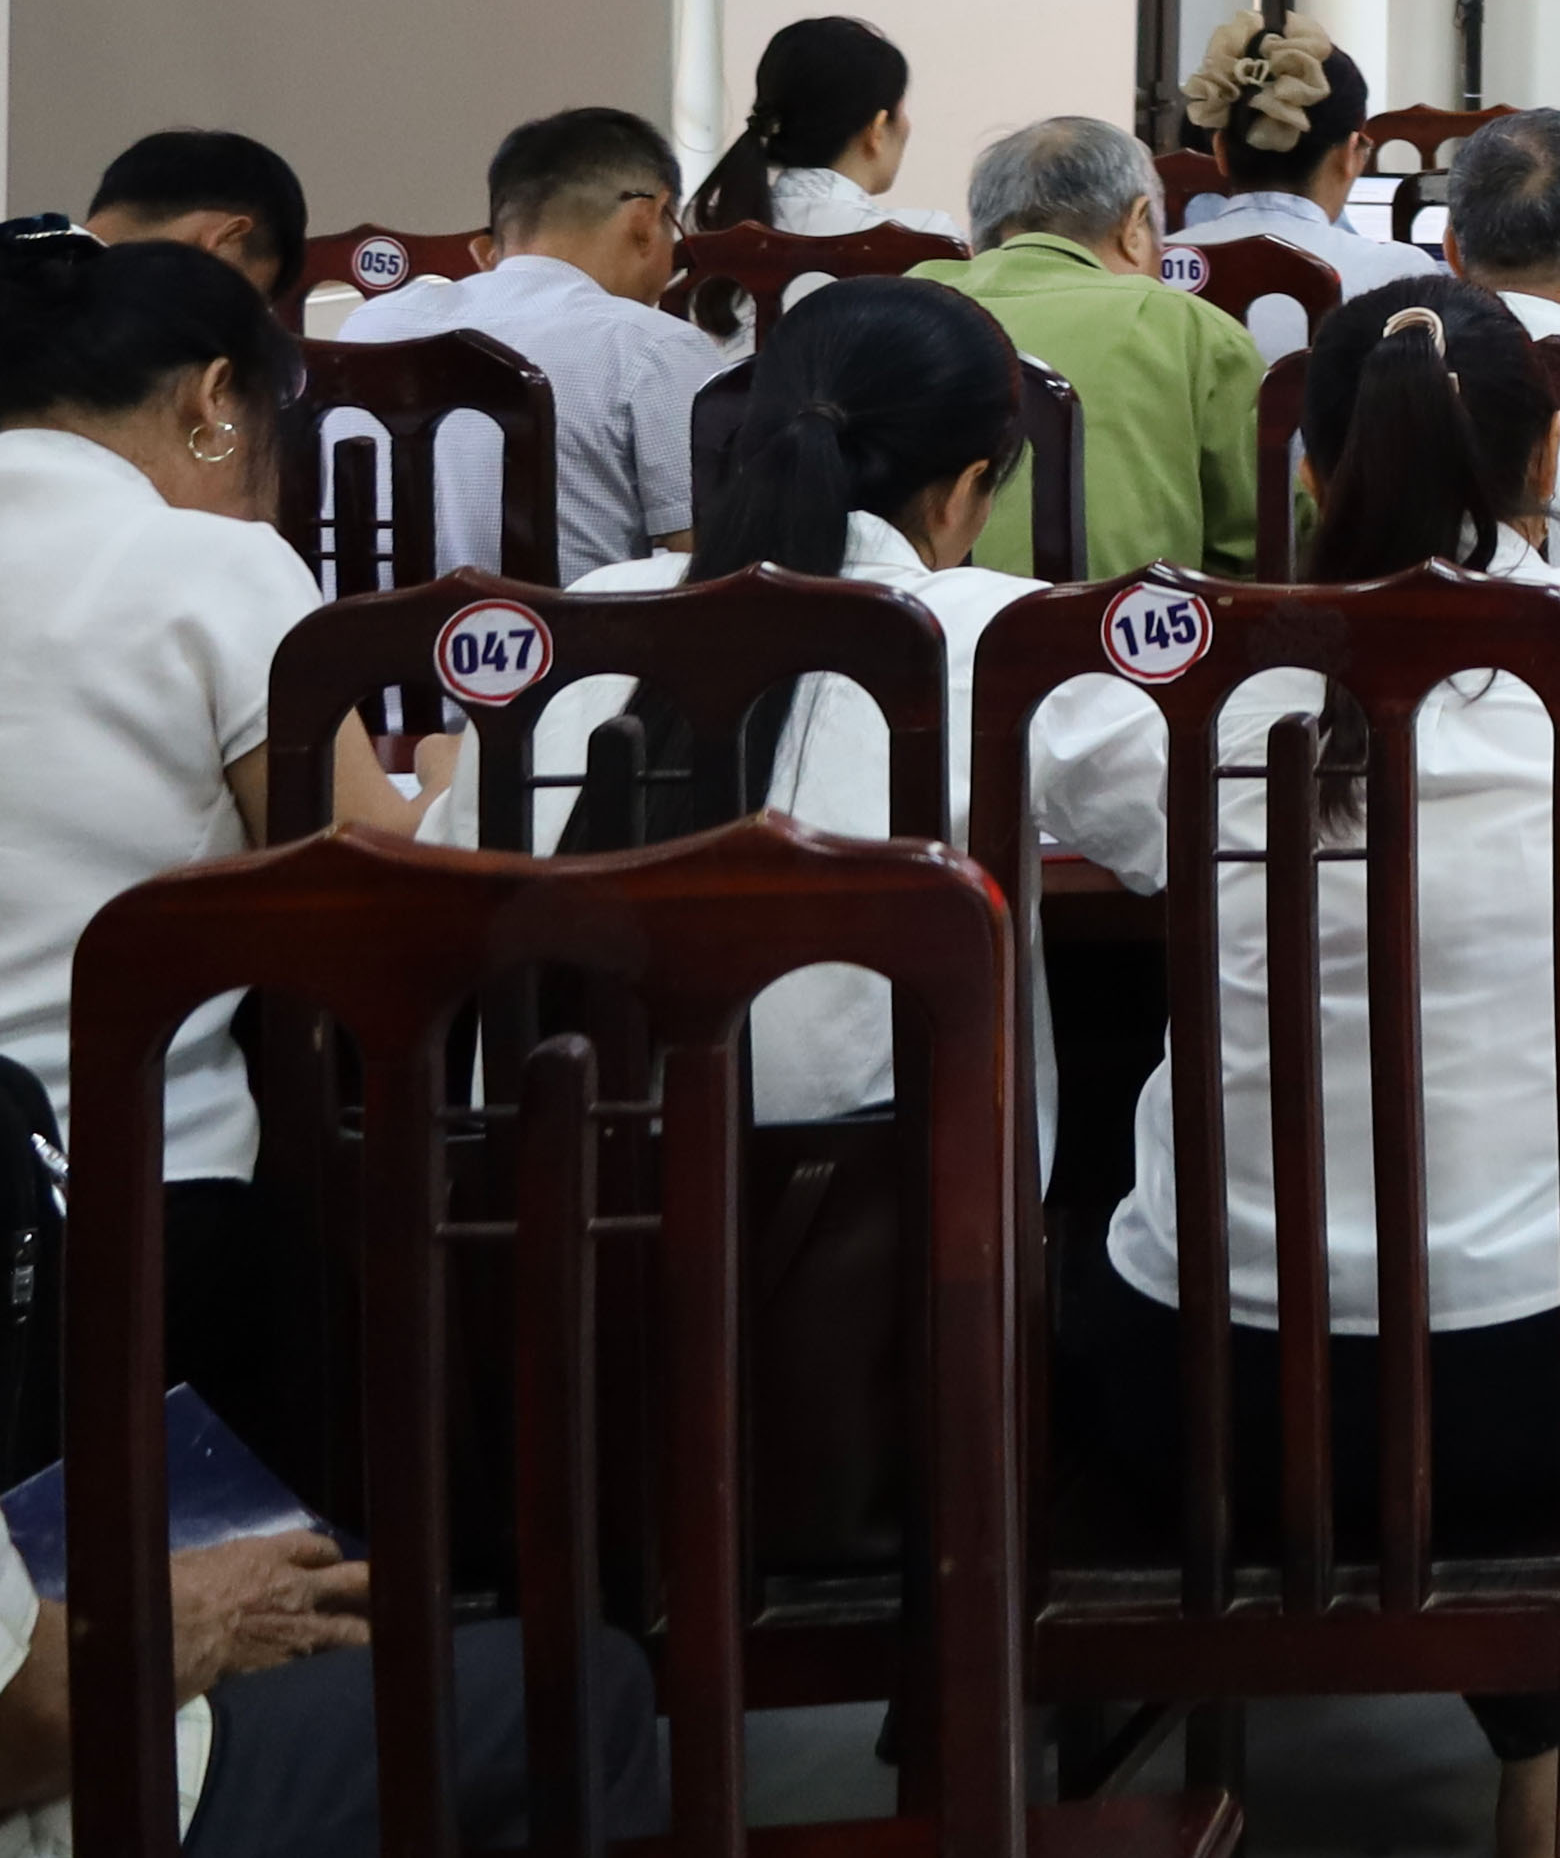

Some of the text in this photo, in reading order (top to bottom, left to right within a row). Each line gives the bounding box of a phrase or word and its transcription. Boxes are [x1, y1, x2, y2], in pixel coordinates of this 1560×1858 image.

[361, 251, 400, 275] 055
[1163, 259, 1200, 280] 016
[1115, 600, 1196, 656] 145
[452, 628, 535, 675] 047
